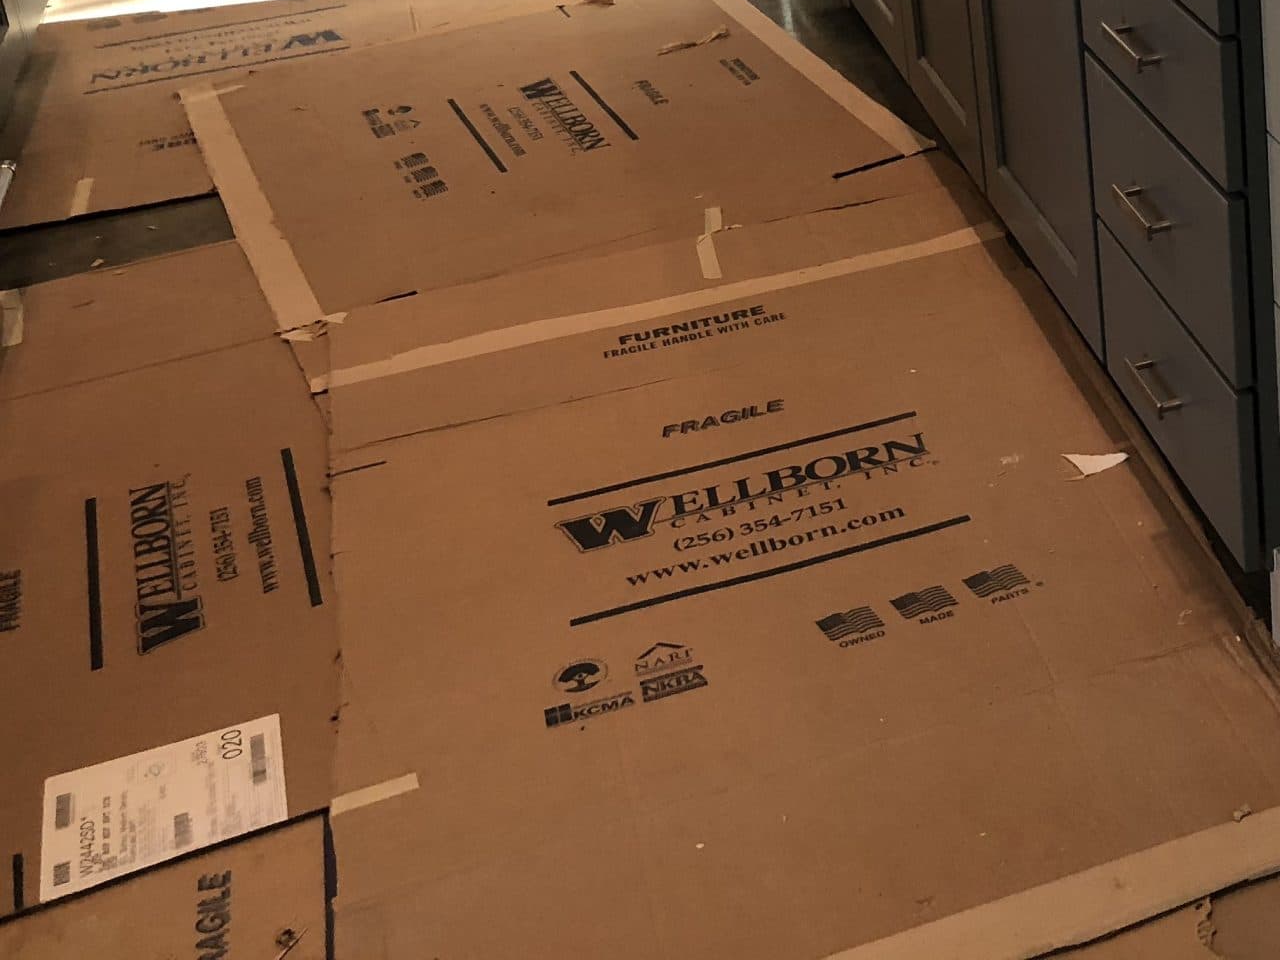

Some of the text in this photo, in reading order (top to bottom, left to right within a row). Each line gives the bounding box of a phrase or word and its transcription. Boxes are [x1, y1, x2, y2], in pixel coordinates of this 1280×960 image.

[518, 77, 611, 153] WELLBORN
[603, 312, 786, 359] FRAGILE HANDLE WITH CARE
[617, 304, 767, 345] FURNITURE
[661, 398, 785, 438] FRAGILE
[554, 431, 930, 553] WELLBORN
[245, 475, 280, 595] www.wellborn.com
[626, 504, 906, 587] www.wellborn.com
[673, 497, 848, 553] (256) 354-7151
[128, 480, 207, 656] WELLBORN
[838, 587, 1030, 649] OWNED MADE PARTS
[573, 695, 635, 721] KCMA
[221, 728, 243, 761] 020
